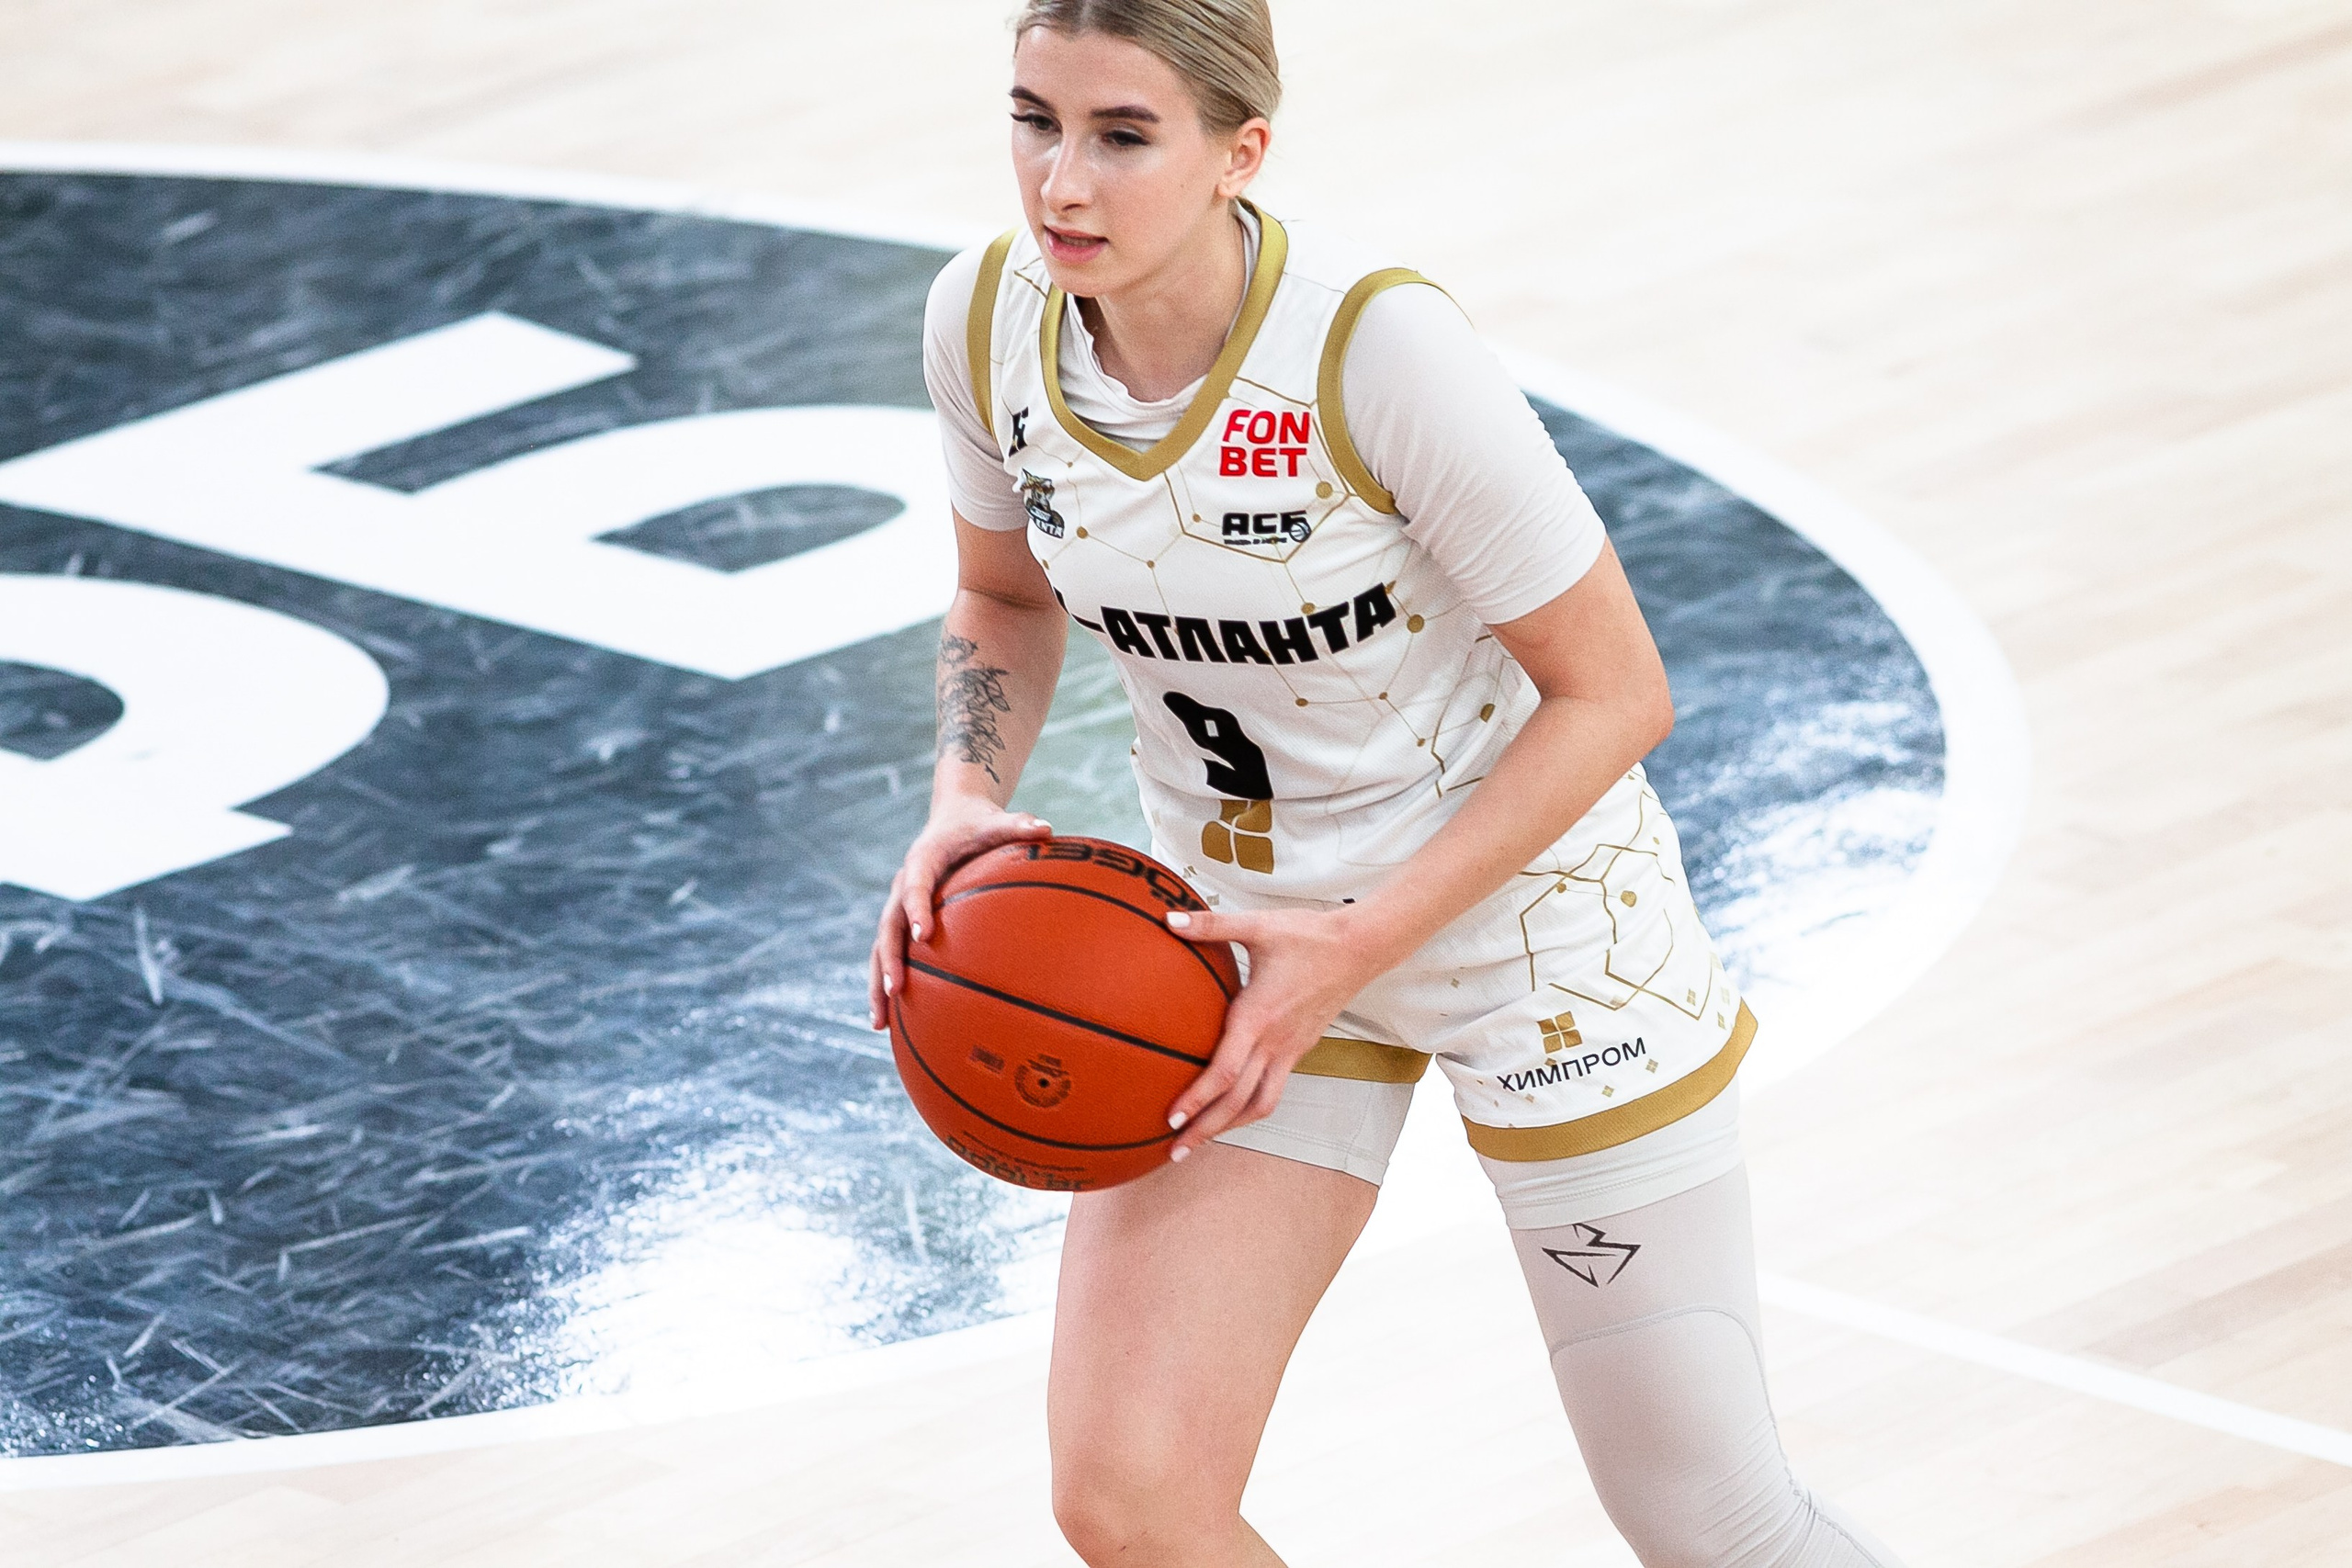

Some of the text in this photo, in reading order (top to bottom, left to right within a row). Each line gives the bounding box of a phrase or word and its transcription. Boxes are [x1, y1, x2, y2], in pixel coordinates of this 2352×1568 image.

[1222, 409, 1310, 445] FON
[1219, 446, 1307, 478] BET
[1053, 582, 1397, 665] -АТЛАНТА
[1162, 691, 1274, 800] 9
[1015, 840, 1207, 912] ÖGEL
[1497, 1036, 1647, 1092] ХИМПРОМ
